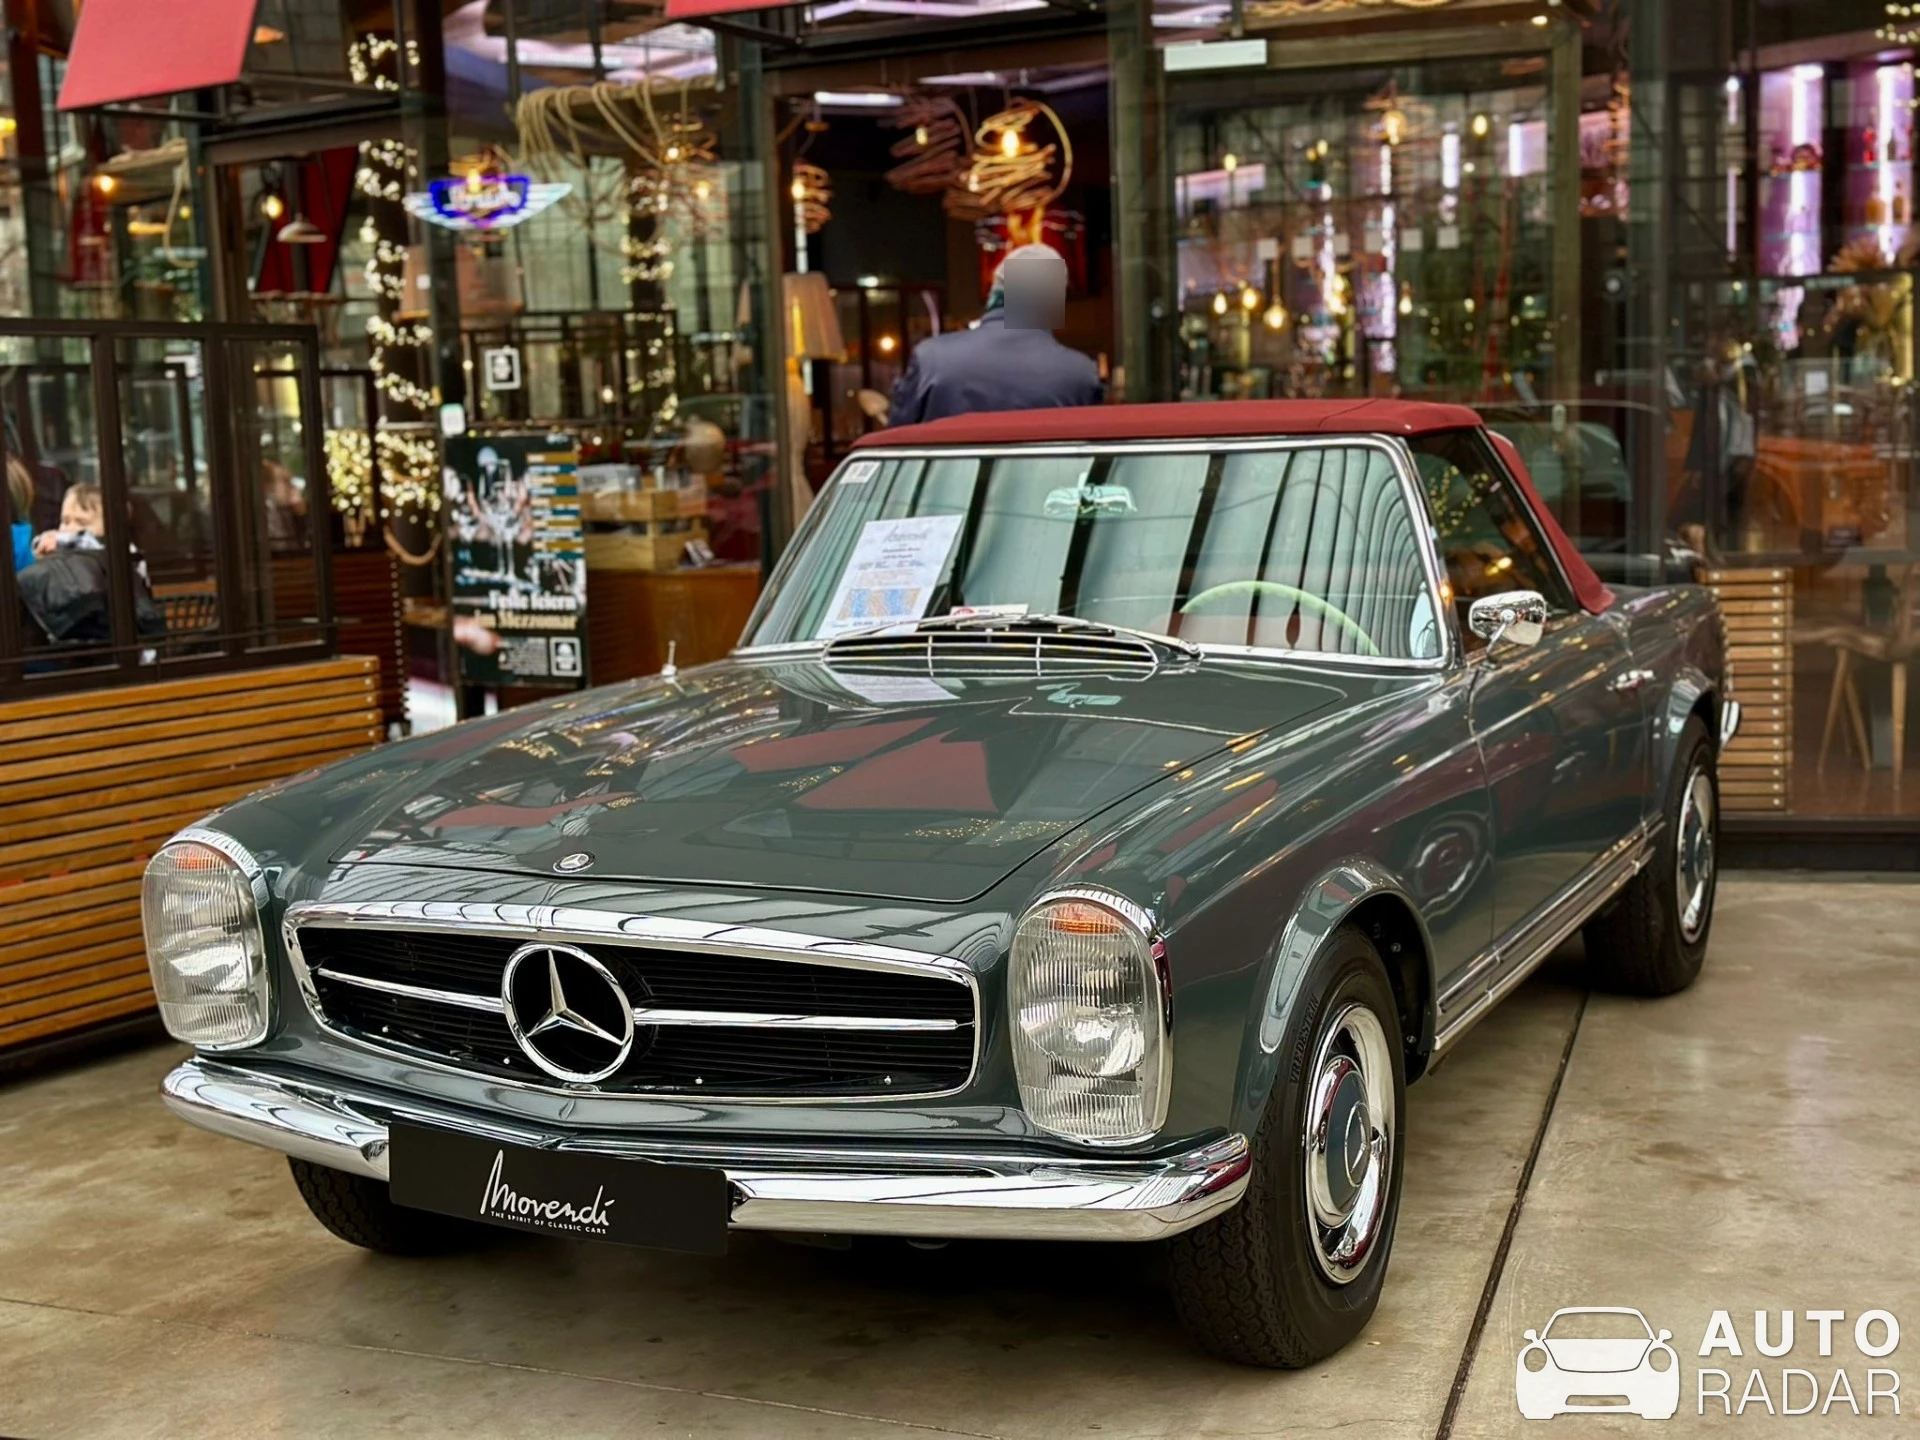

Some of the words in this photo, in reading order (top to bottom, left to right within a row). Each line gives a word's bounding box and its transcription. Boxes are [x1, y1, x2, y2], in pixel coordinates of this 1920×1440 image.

[1290, 992, 1319, 1083] VREDESTEIN
[480, 1149, 615, 1226] Movendi
[490, 1211, 504, 1219] THE
[507, 1214, 532, 1224] SPIRIT
[534, 1218, 545, 1227] OF
[547, 1221, 582, 1231] CLASSIC
[585, 1226, 607, 1235] CARS
